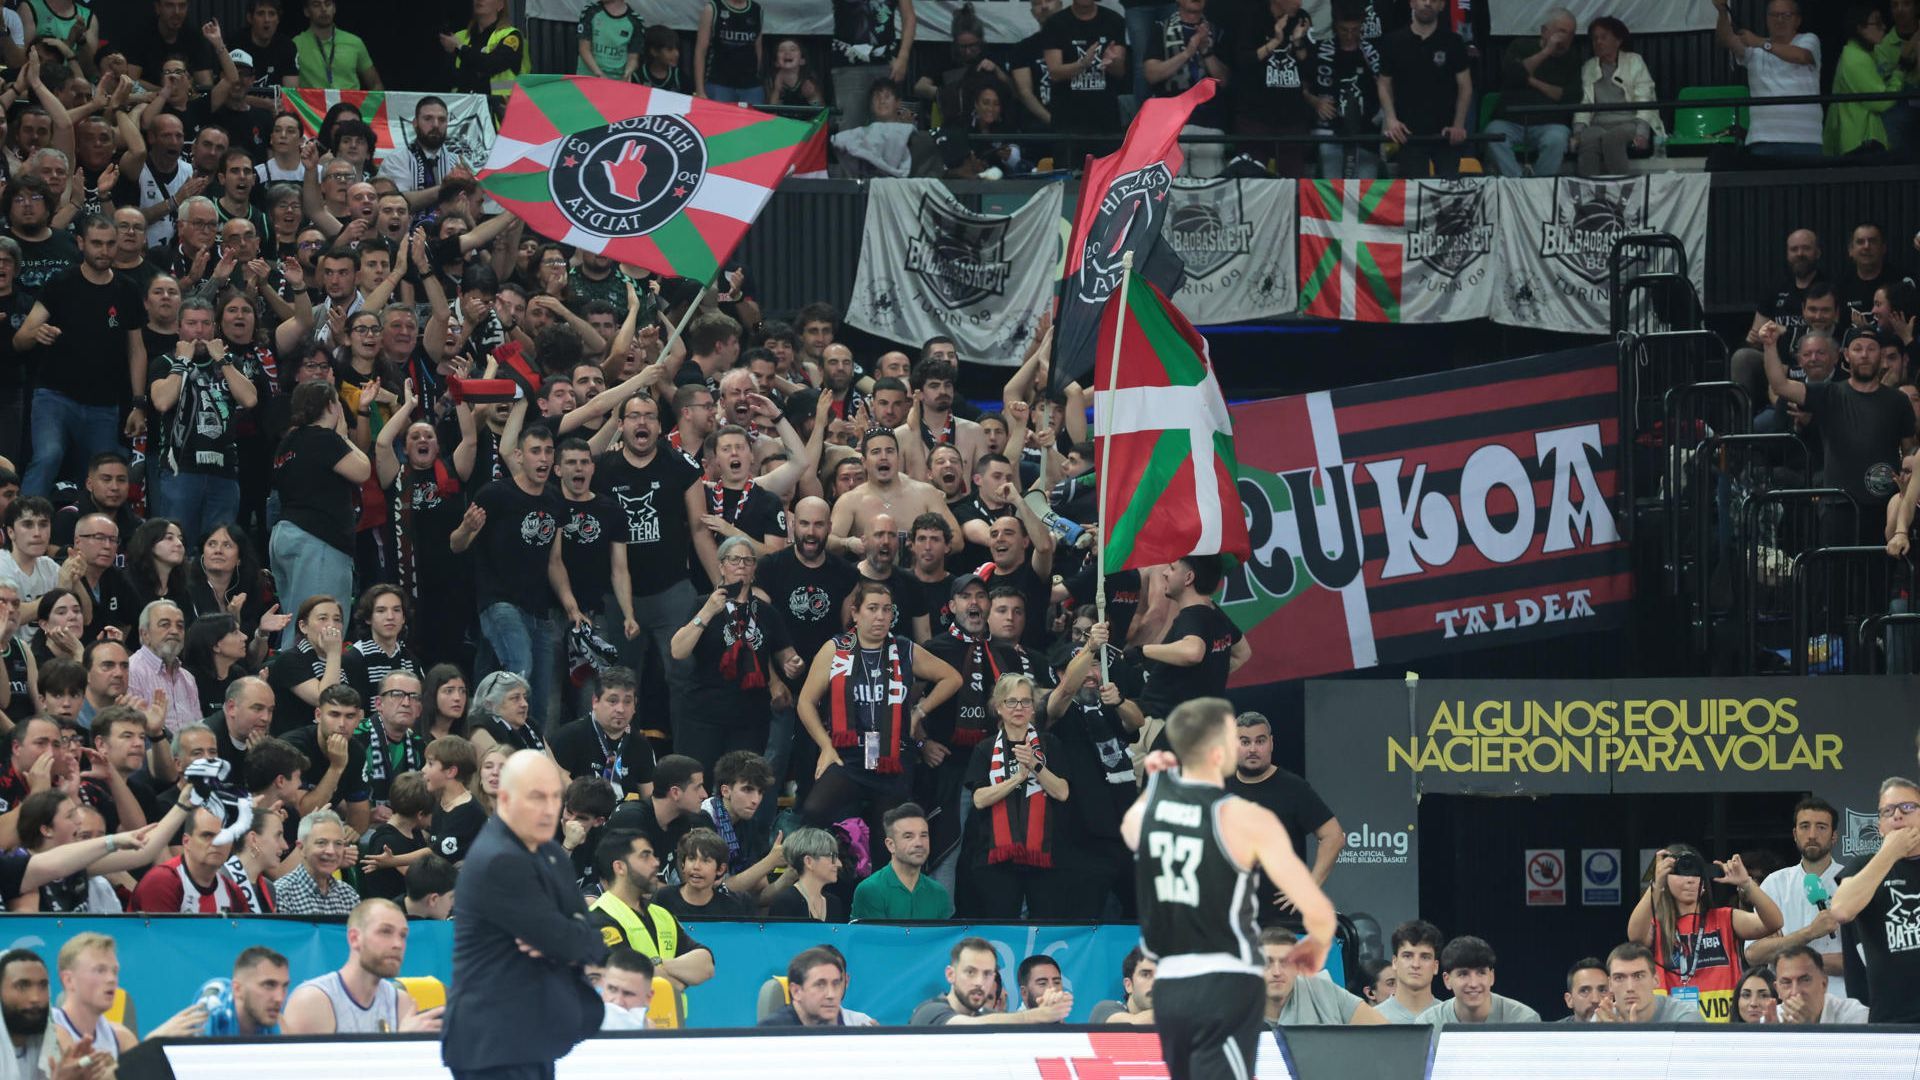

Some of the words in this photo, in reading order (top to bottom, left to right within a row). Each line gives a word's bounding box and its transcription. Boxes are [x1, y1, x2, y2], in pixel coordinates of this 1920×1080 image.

[1172, 222, 1252, 254] BAOBASKET
[1181, 281, 1214, 296] RIN
[1220, 268, 1242, 288] 09
[1555, 274, 1609, 301] TURIN
[969, 309, 991, 325] 09
[628, 516, 661, 541] TERA
[1435, 588, 1596, 640] TALDEA
[1427, 700, 1619, 737] ALGUNOS
[1624, 698, 1798, 744] EQUIPOS
[1388, 736, 1592, 772] NACIERON
[1599, 736, 1702, 772] PARA
[1706, 734, 1843, 771] VOLAR
[1343, 823, 1408, 855] eling
[1702, 936, 1720, 949] IBA
[1885, 921, 1920, 949] BATE
[1698, 997, 1734, 1018] VID
